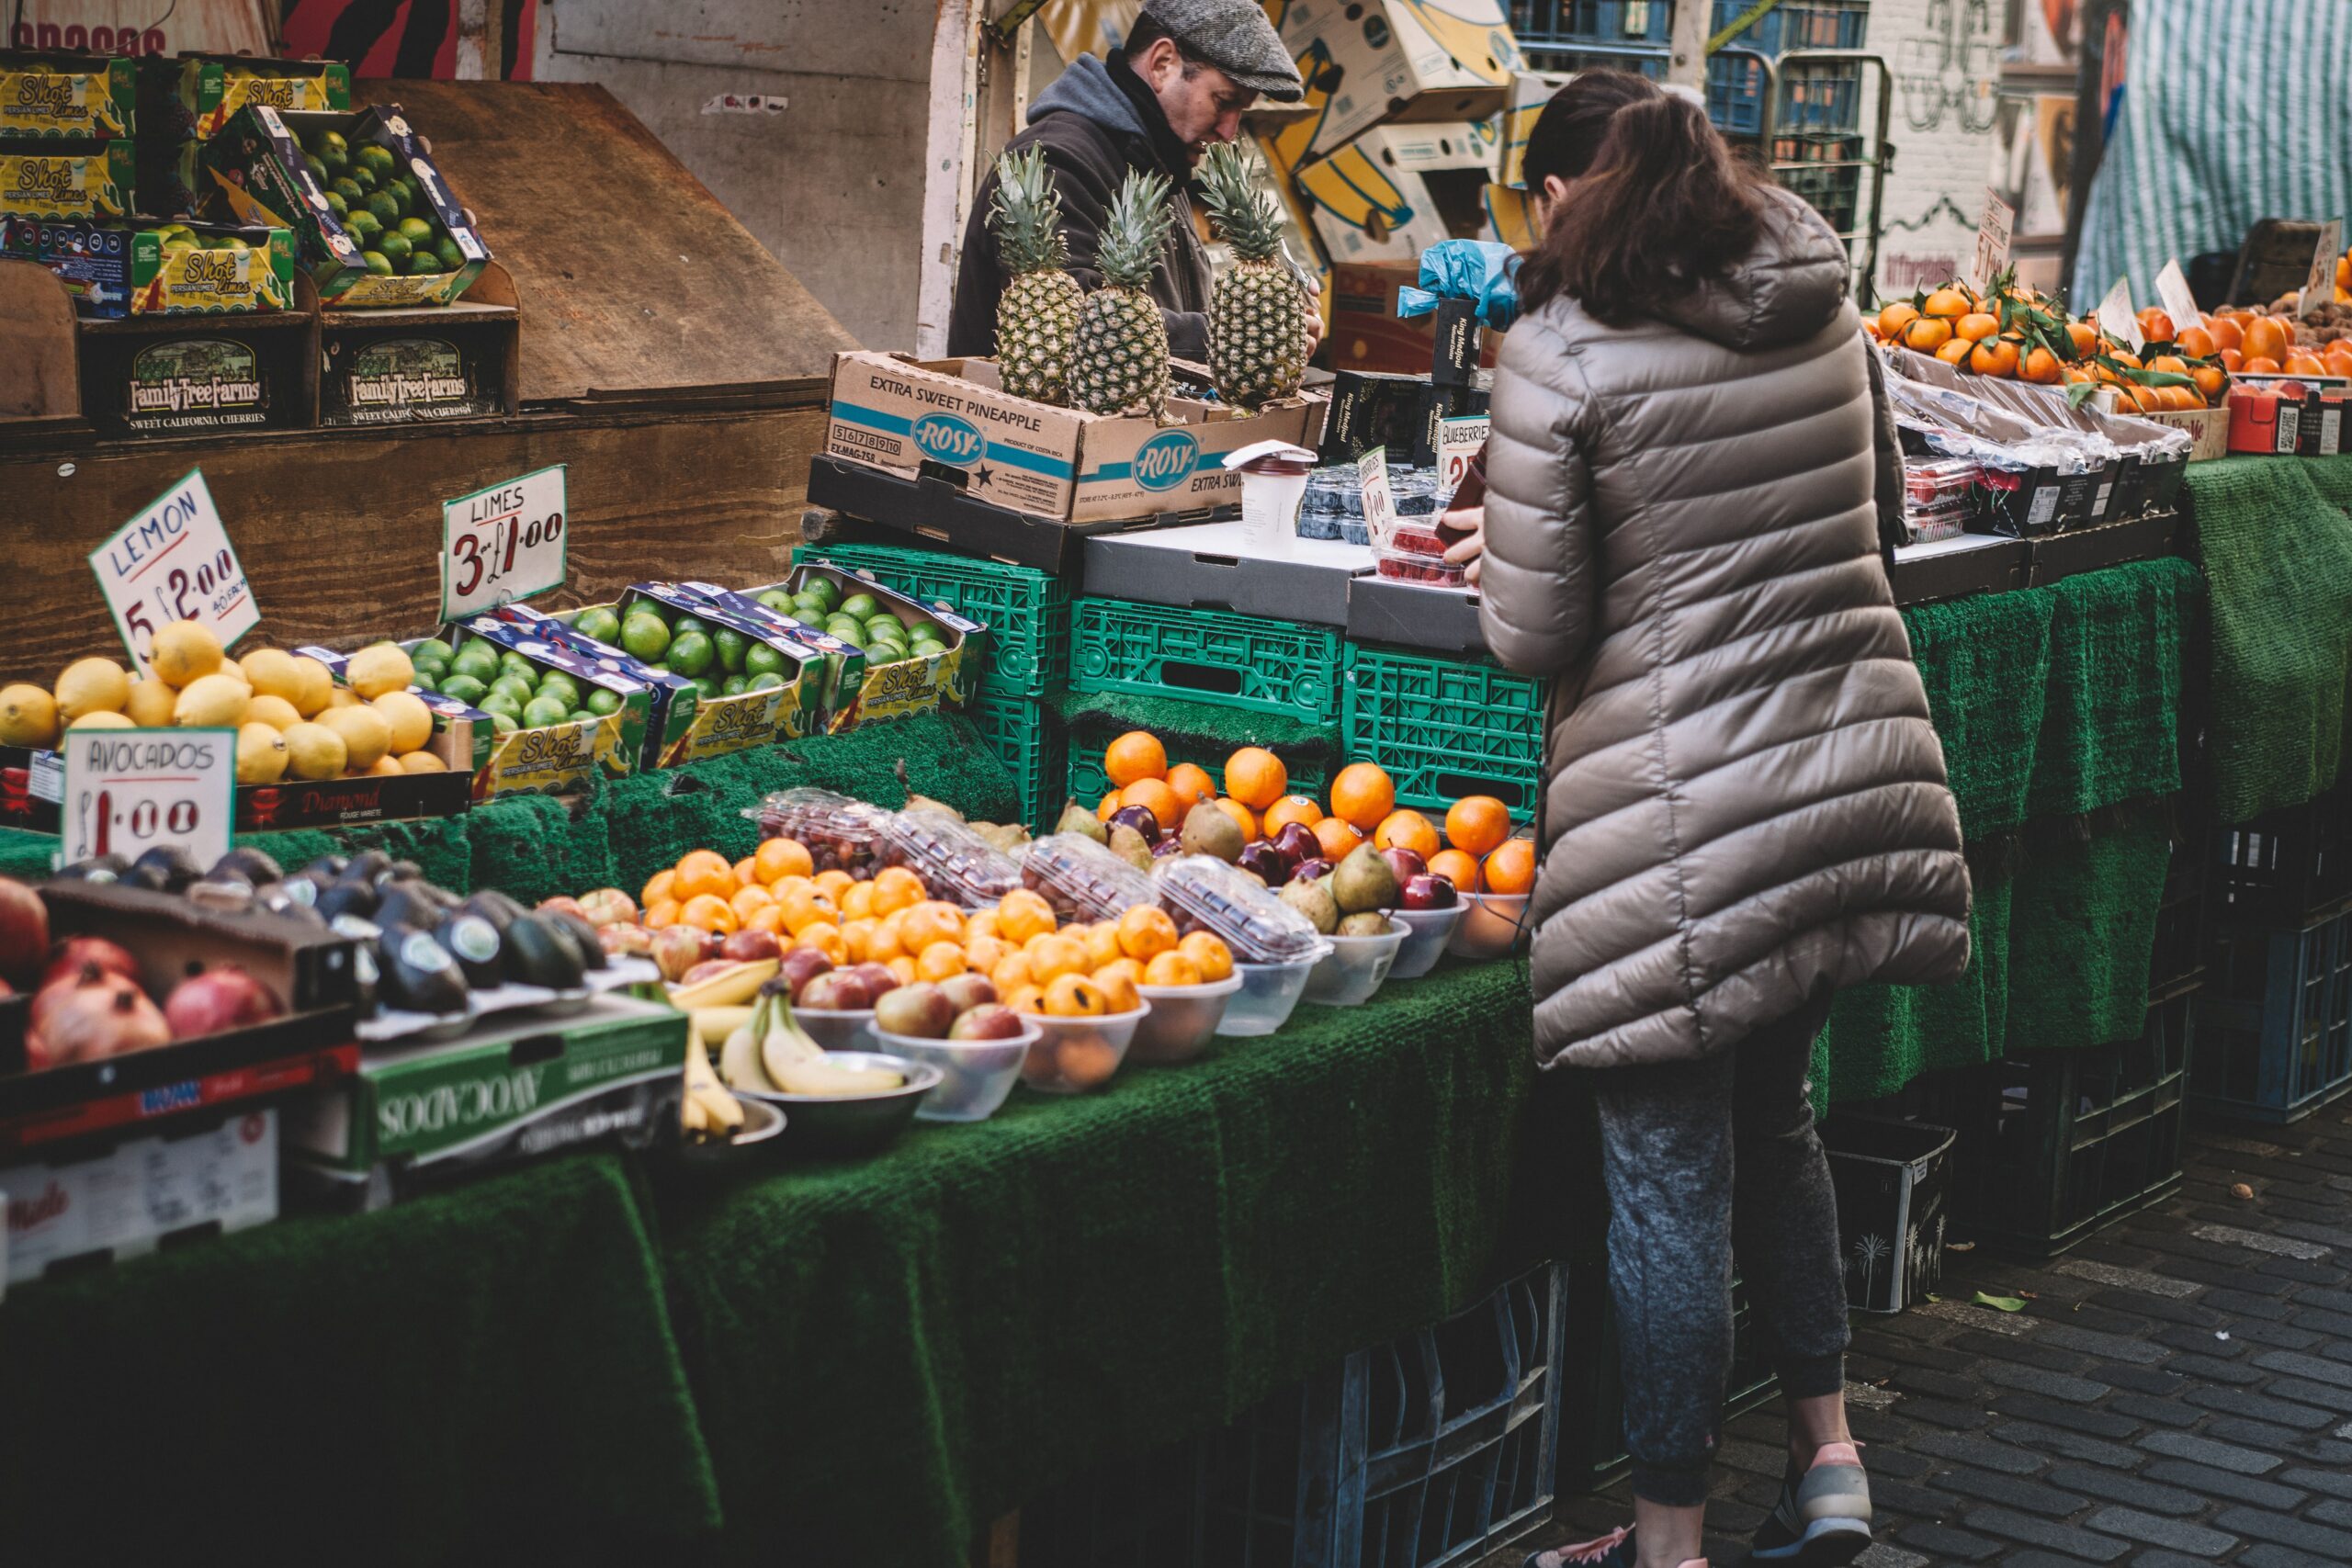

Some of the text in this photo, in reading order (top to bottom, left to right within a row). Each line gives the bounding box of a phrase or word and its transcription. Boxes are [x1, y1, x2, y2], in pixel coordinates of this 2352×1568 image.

[18, 73, 73, 106] Shot
[246, 79, 294, 107] Shot
[51, 102, 88, 118] Limes
[18, 158, 73, 190] Shot
[51, 186, 88, 204] Limes
[185, 251, 237, 283] Shot
[214, 276, 251, 295] Limes
[1454, 317, 1467, 368] King Medjoul
[130, 376, 260, 412] Family Tree Farms
[870, 376, 1042, 432] EXTRA SWEET PINEAPPLE
[130, 412, 266, 430] SWEET CALIFORNIA CHERRIES
[353, 410, 382, 423] SWEET
[1340, 392, 1354, 443] King Medjoul
[1433, 402, 1443, 422] King
[836, 427, 899, 453] 5 6 7 8 9 10
[921, 421, 977, 456] ROSY
[1004, 437, 1027, 448] PRODUCT
[1035, 445, 1050, 455] COSTA
[1050, 448, 1063, 457] RICA
[1139, 445, 1193, 479] ROSY
[1191, 475, 1221, 492] EXTRA
[471, 487, 525, 523] LIMES
[111, 491, 198, 577] LEMON
[454, 534, 483, 596] 3
[487, 513, 563, 584] £1.00
[227, 578, 247, 601] EACH
[125, 600, 155, 664] 5
[882, 659, 929, 695] Shot
[714, 696, 768, 733] Shot
[88, 740, 215, 773] AVOCADOS
[520, 724, 582, 763] Shot
[503, 763, 532, 777] PERSIAN
[302, 781, 385, 814] Diamond
[340, 809, 360, 819] ROUGE
[76, 790, 200, 858] £1.00
[378, 1064, 546, 1143] AVOCADOS
